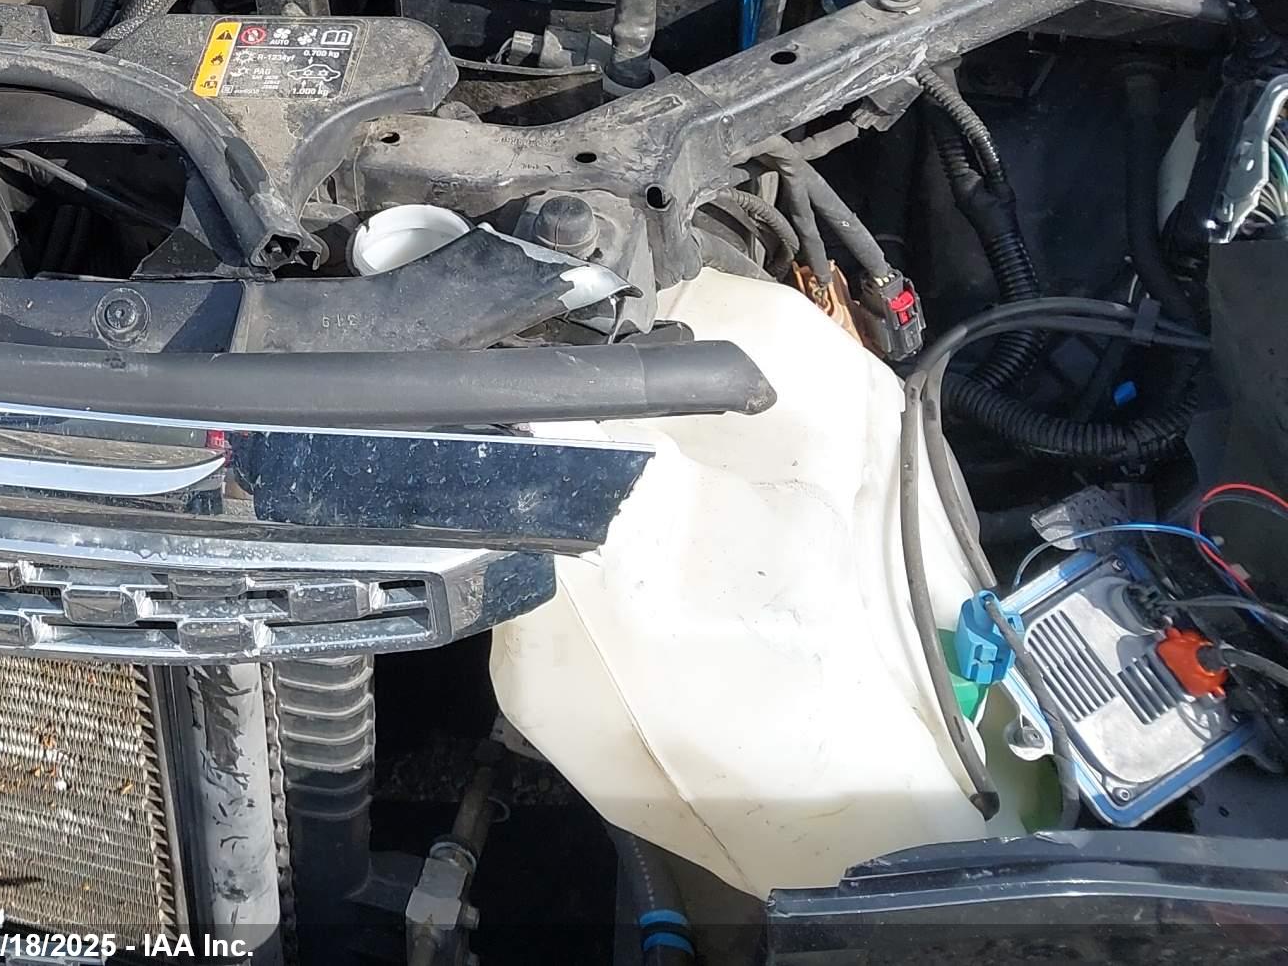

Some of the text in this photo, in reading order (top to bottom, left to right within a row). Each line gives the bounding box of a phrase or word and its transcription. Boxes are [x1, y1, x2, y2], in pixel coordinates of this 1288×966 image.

[269, 38, 290, 46] AUTO
[303, 49, 340, 59] 0.700 kg
[292, 87, 329, 97] 1.000 kg
